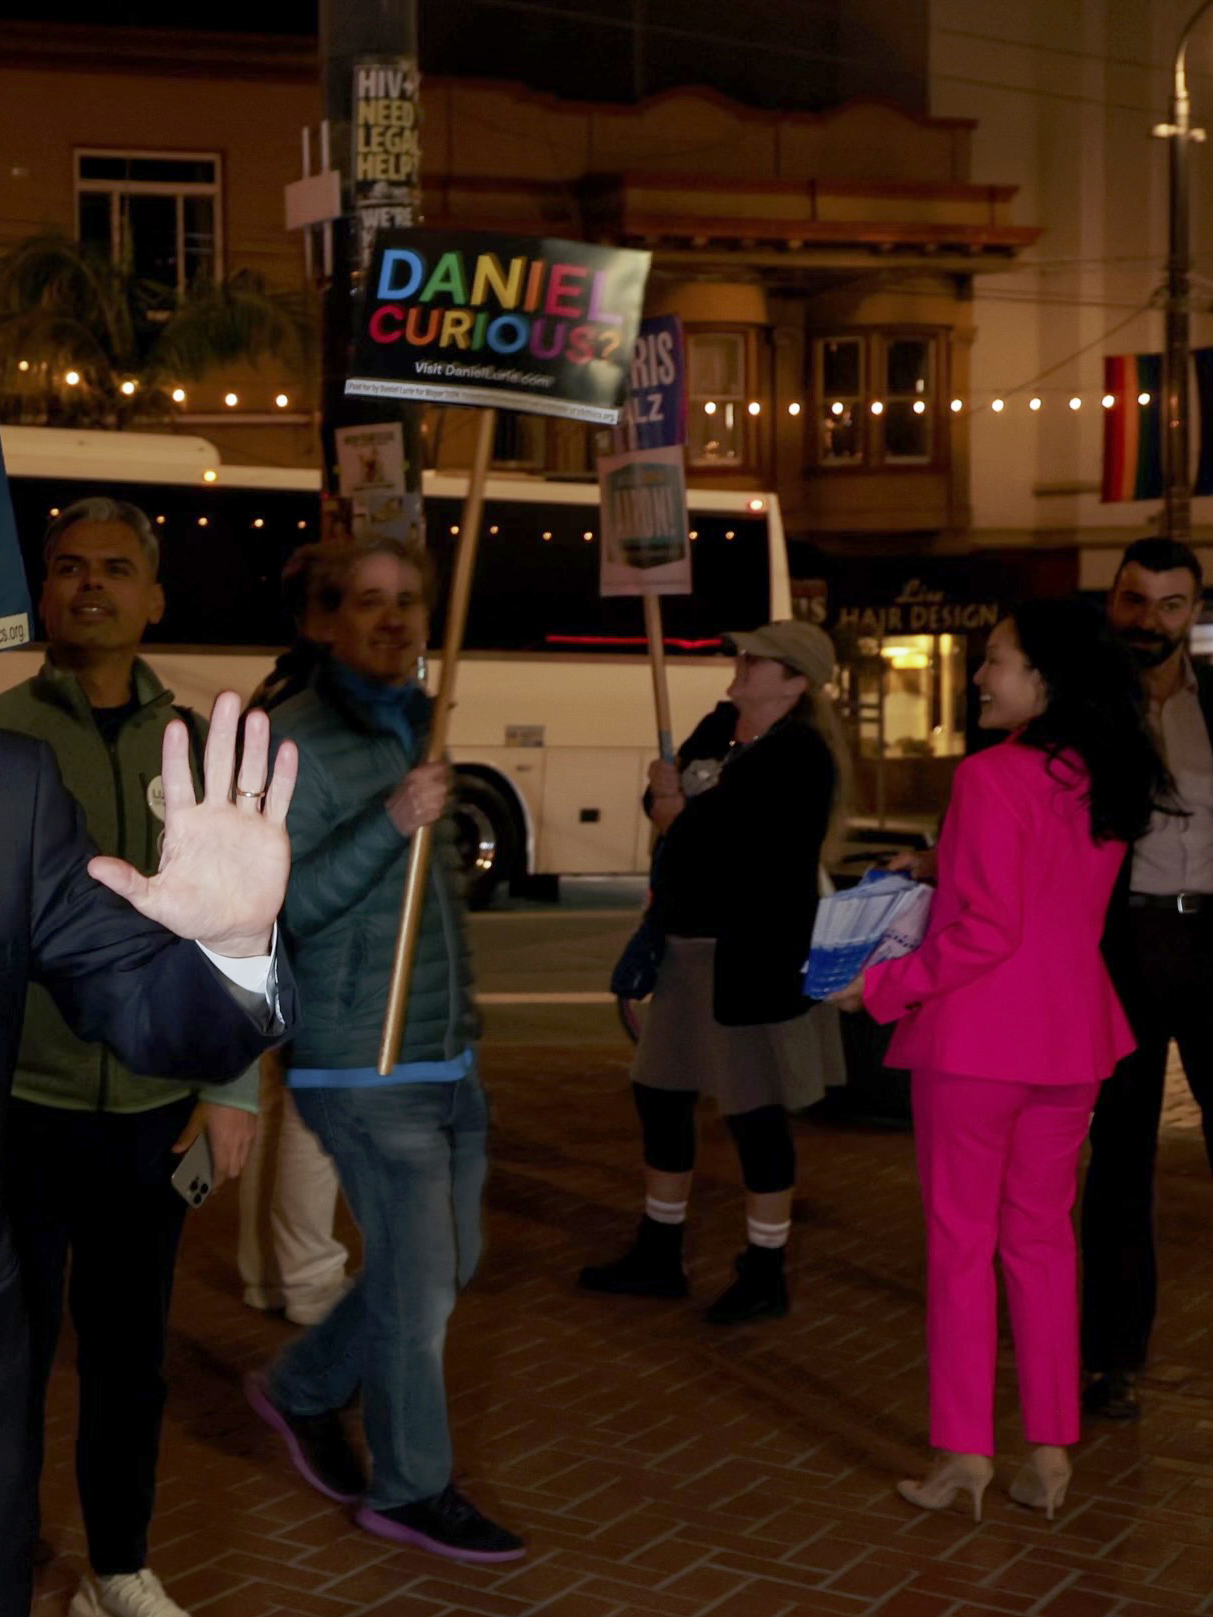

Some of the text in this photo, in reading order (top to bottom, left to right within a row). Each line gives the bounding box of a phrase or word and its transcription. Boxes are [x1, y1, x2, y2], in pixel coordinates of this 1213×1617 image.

[358, 101, 414, 126] NEED
[376, 248, 623, 325] DANIEL
[369, 304, 622, 366] CURIOUS?
[415, 360, 443, 375] Visit
[631, 330, 676, 389] RIS
[840, 607, 902, 631] HAIR
[910, 604, 999, 630] DESIGN
